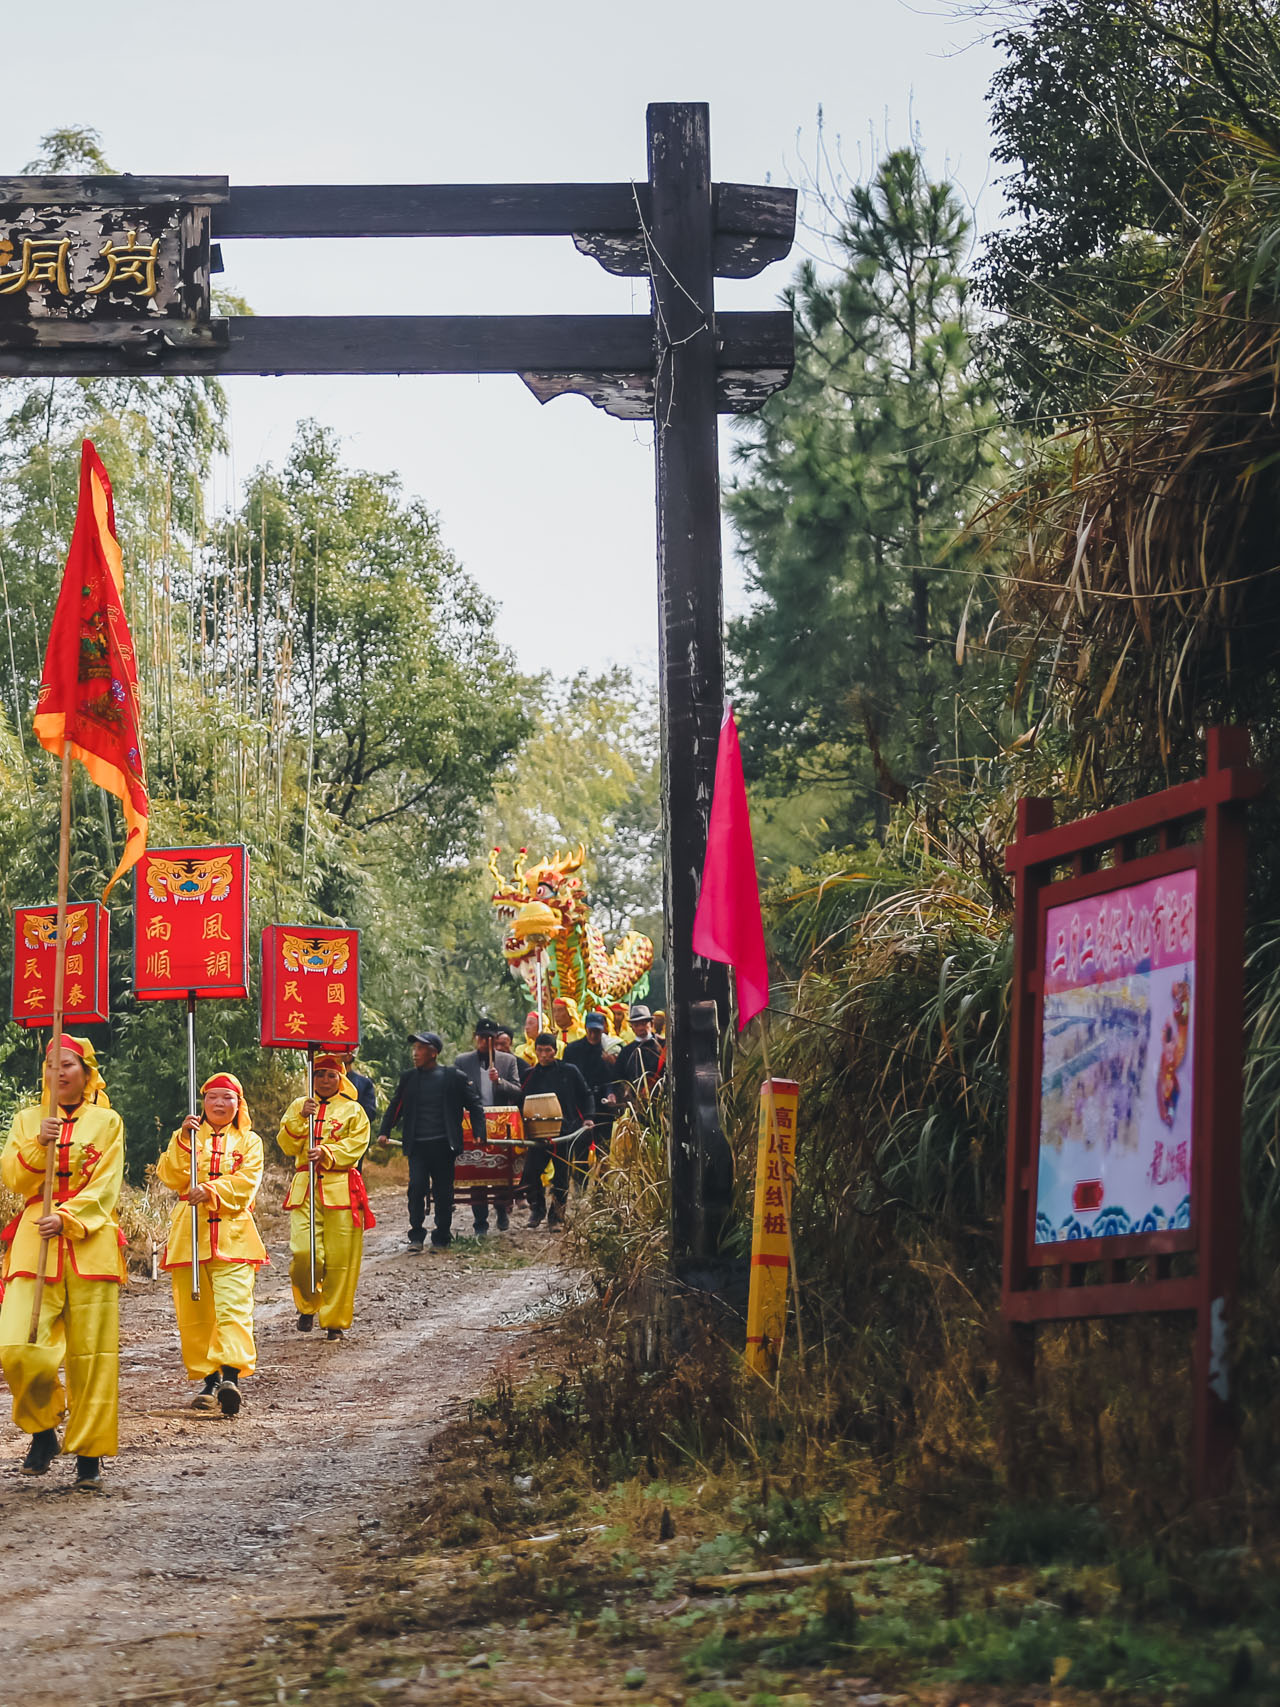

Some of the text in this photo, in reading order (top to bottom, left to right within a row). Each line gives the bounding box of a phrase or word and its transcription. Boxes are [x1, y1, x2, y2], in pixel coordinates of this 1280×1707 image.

[146, 915, 171, 979] 雨順
[202, 912, 231, 979] 風調
[24, 958, 46, 1009] 民安
[66, 954, 87, 1006] 國泰
[283, 980, 308, 1035] 民安
[328, 983, 350, 1037] 國泰
[764, 1107, 794, 1235] 高压巡线桩
